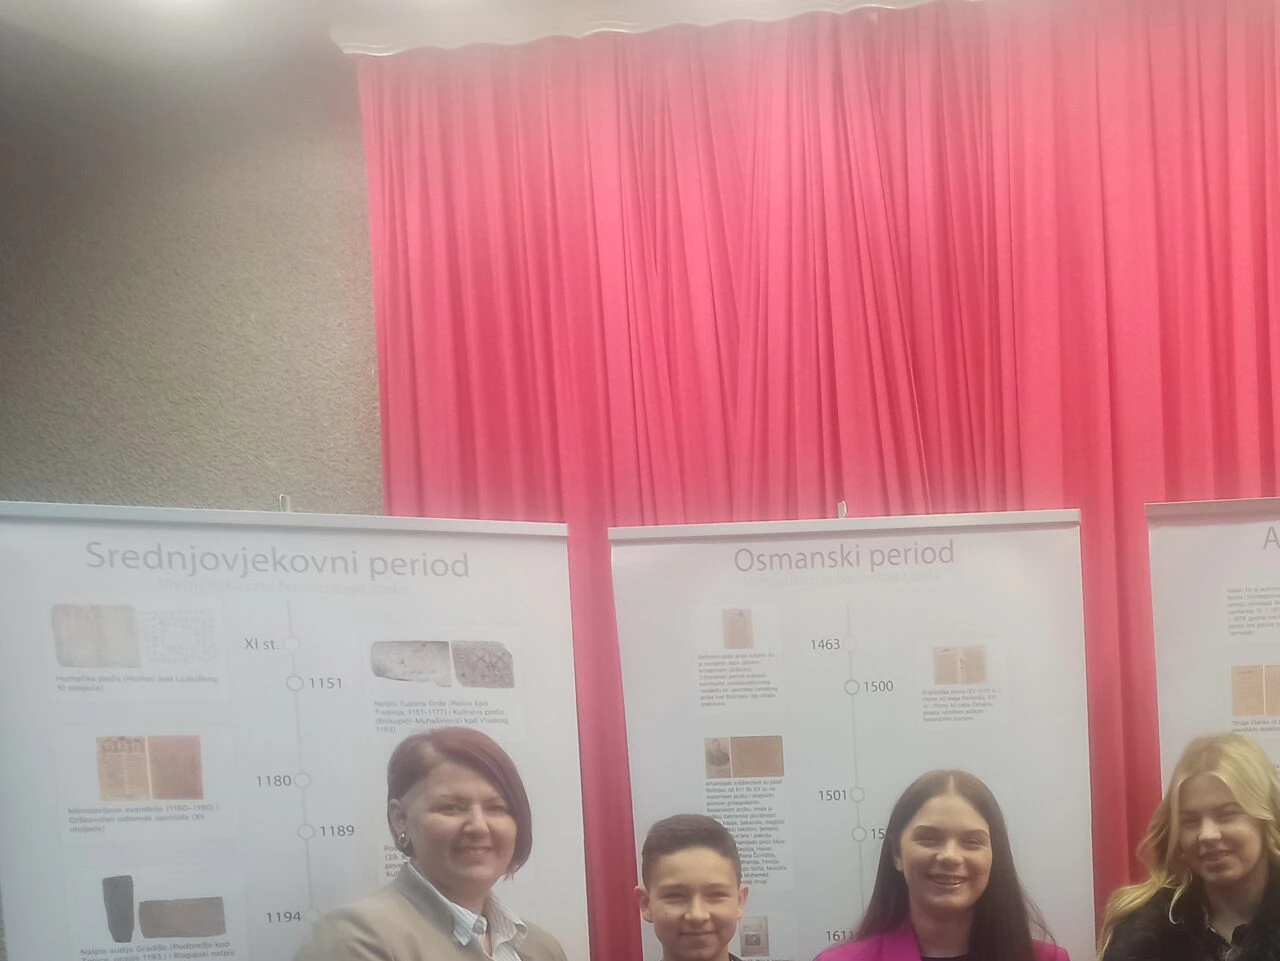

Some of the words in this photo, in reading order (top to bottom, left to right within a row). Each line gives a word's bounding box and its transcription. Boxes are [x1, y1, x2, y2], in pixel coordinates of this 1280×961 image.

[86, 541, 358, 578] Srednjovjekovni
[369, 552, 470, 582] period
[734, 543, 861, 573] Osmanski
[870, 538, 955, 573] period
[244, 637, 259, 650] XI
[262, 638, 280, 650] st.
[811, 639, 841, 651] 1463
[309, 677, 343, 690] 1151
[864, 680, 894, 692] 1500
[257, 775, 292, 788] 1180
[818, 790, 848, 802] 1501
[320, 825, 355, 838] 1189
[267, 911, 302, 924] 1194
